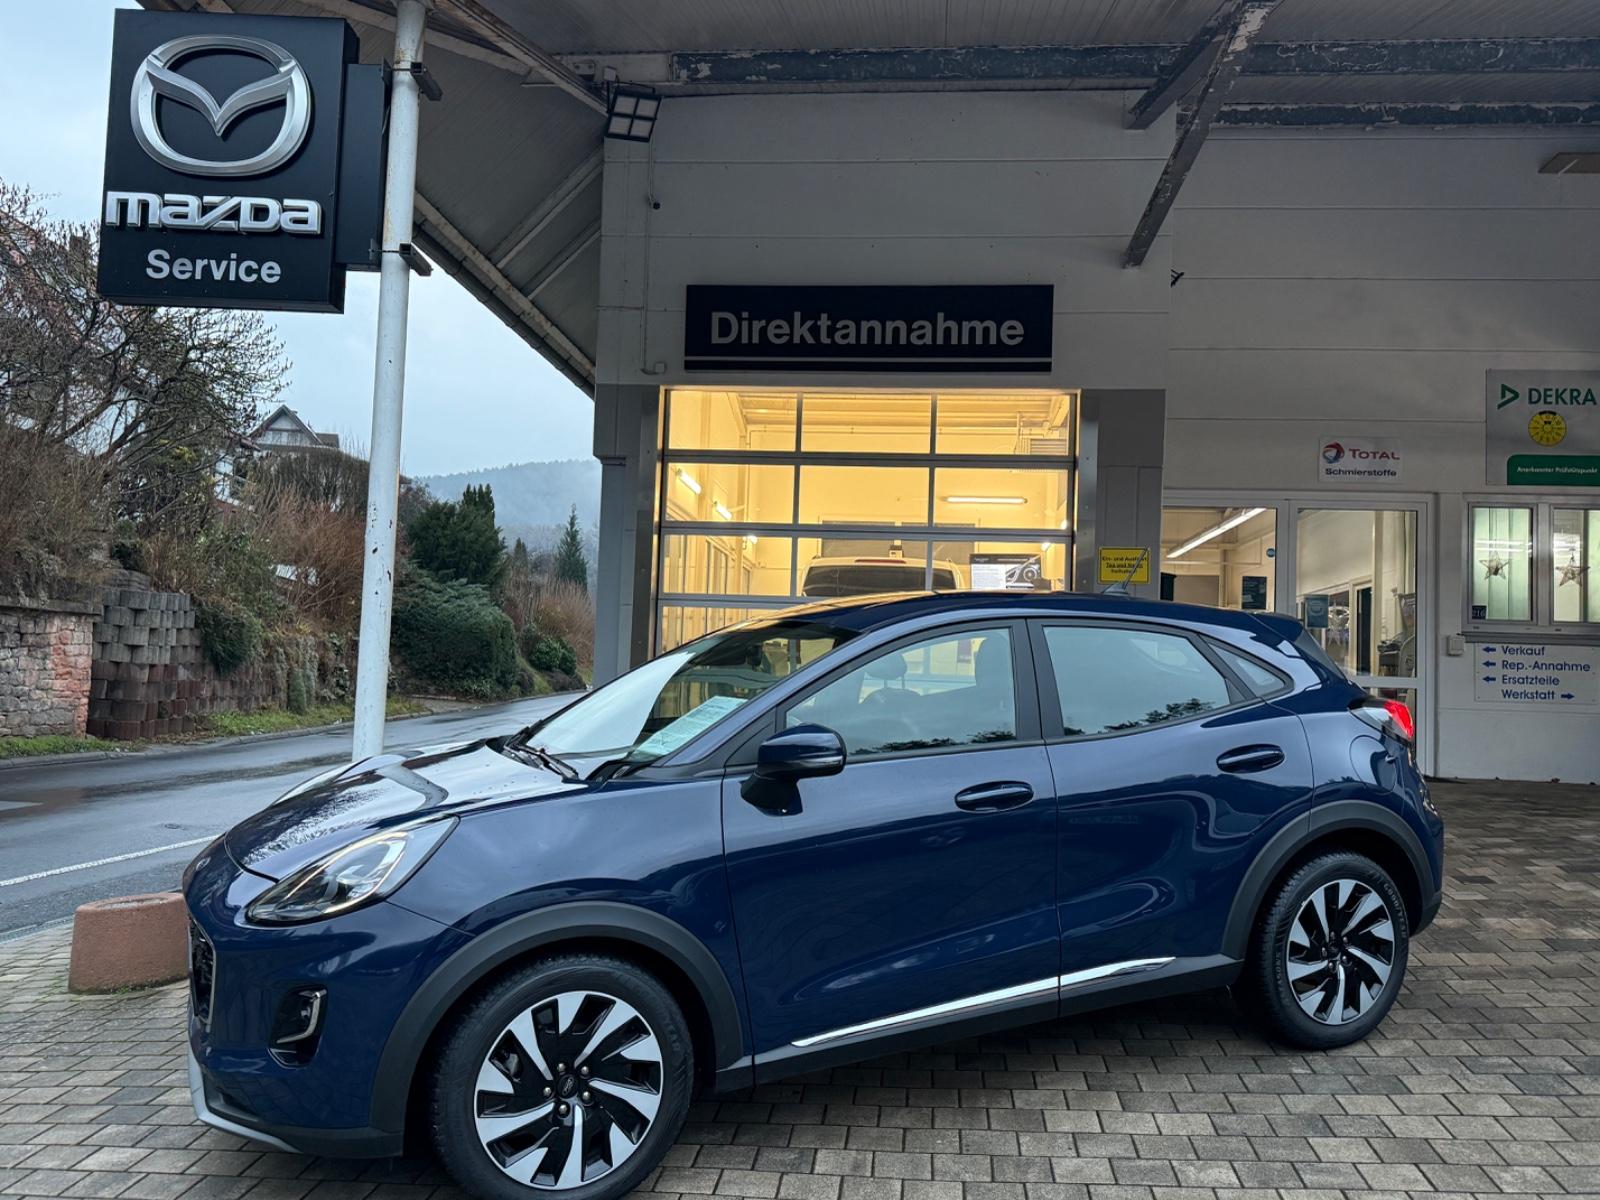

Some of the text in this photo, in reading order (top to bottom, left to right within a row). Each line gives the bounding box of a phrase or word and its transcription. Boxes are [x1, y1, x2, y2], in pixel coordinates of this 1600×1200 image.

[146, 249, 281, 284] Service
[710, 311, 1024, 346] Direktannahme
[1528, 387, 1597, 405] DEKRA
[1325, 468, 1397, 477] Schmierstoffe
[1501, 645, 1545, 656] Verkauf
[1501, 660, 1590, 672] Rep.-Annahme
[1501, 675, 1560, 686] Ersatzteile
[1501, 689, 1554, 700] Werkstatt
